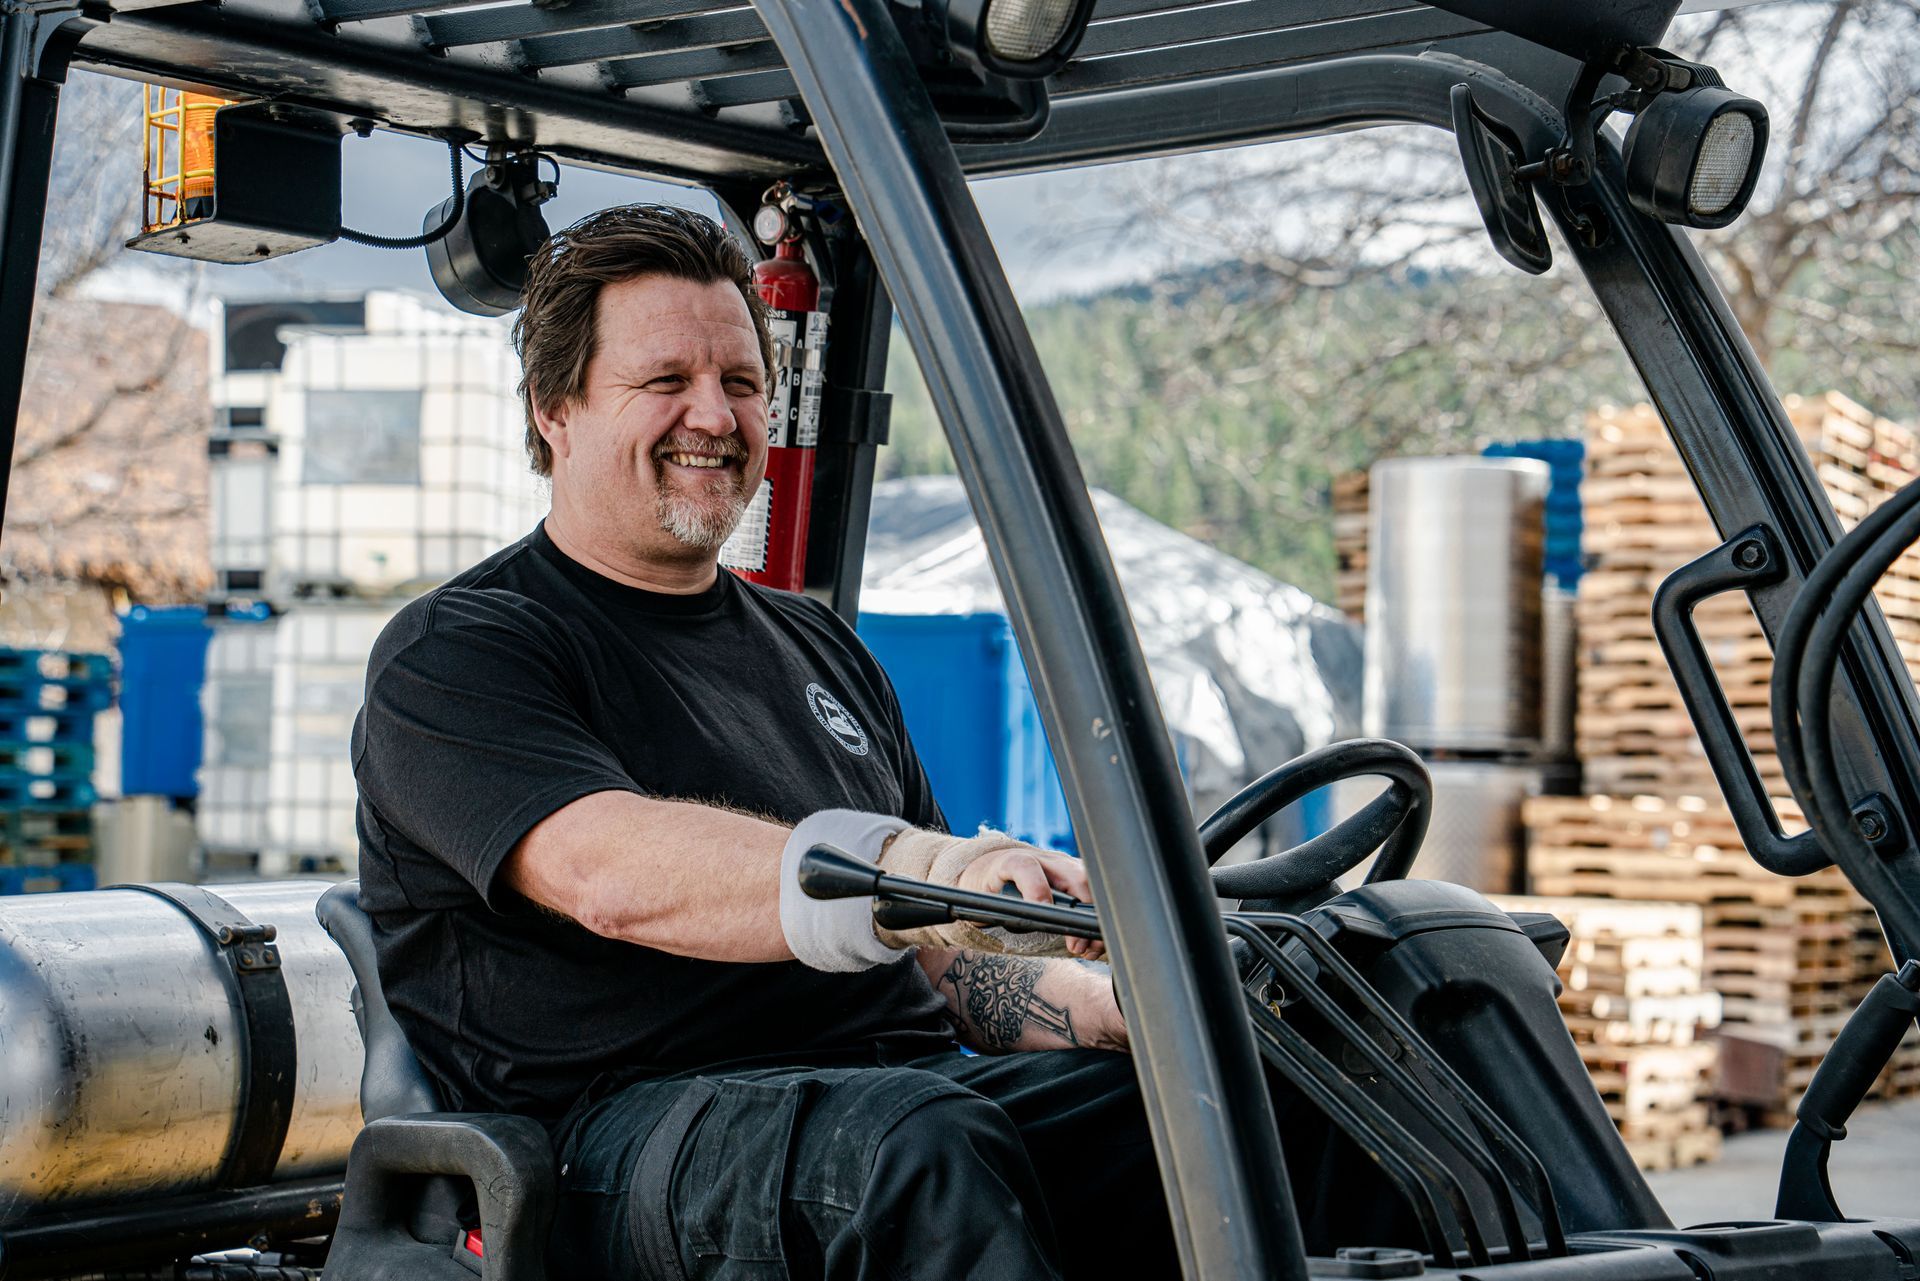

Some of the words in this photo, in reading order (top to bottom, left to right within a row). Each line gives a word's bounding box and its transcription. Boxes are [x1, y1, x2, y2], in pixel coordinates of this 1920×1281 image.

[796, 338, 803, 349] A
[793, 373, 801, 386] B
[789, 407, 798, 420] C
